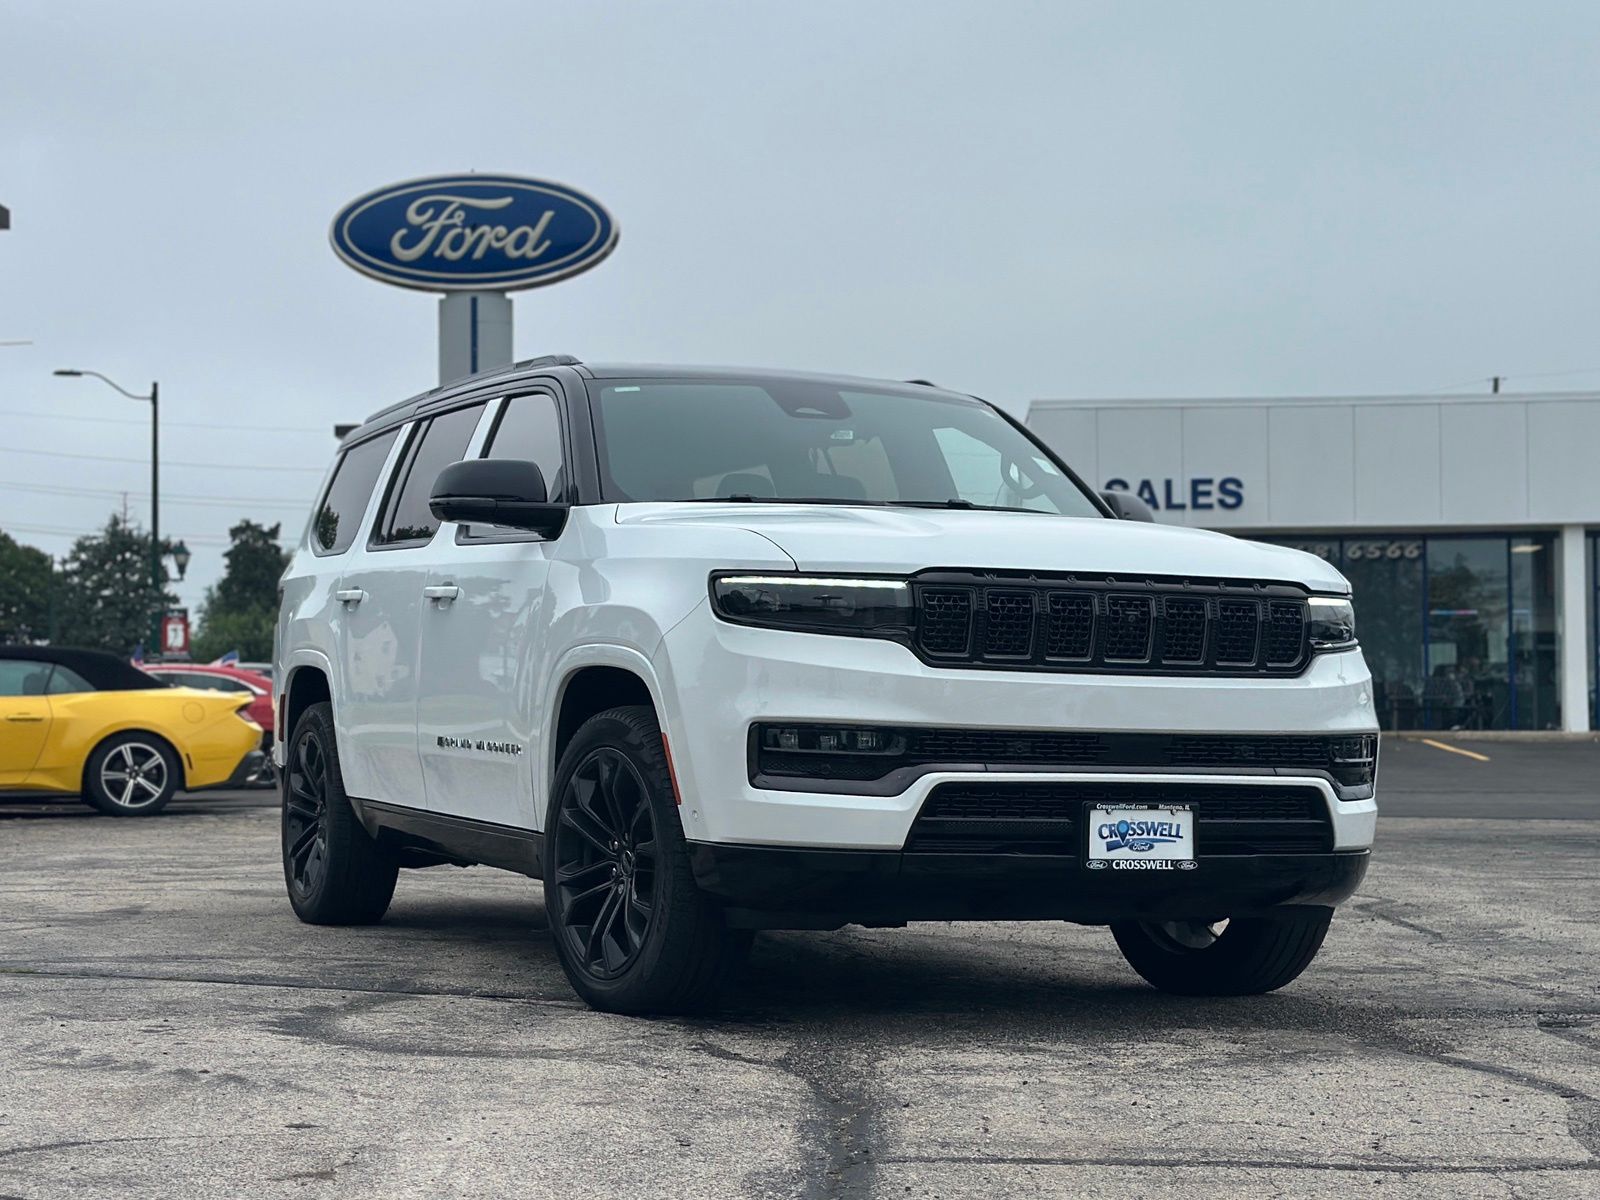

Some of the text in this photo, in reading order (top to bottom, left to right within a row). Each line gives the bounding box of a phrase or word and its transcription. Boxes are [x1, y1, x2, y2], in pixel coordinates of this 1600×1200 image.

[391, 195, 555, 261] Ford
[1348, 543, 1420, 559] 6566
[984, 573, 1262, 592] WAGONEER
[1132, 841, 1150, 851] Ford
[1112, 860, 1174, 870] CROSSWELL
